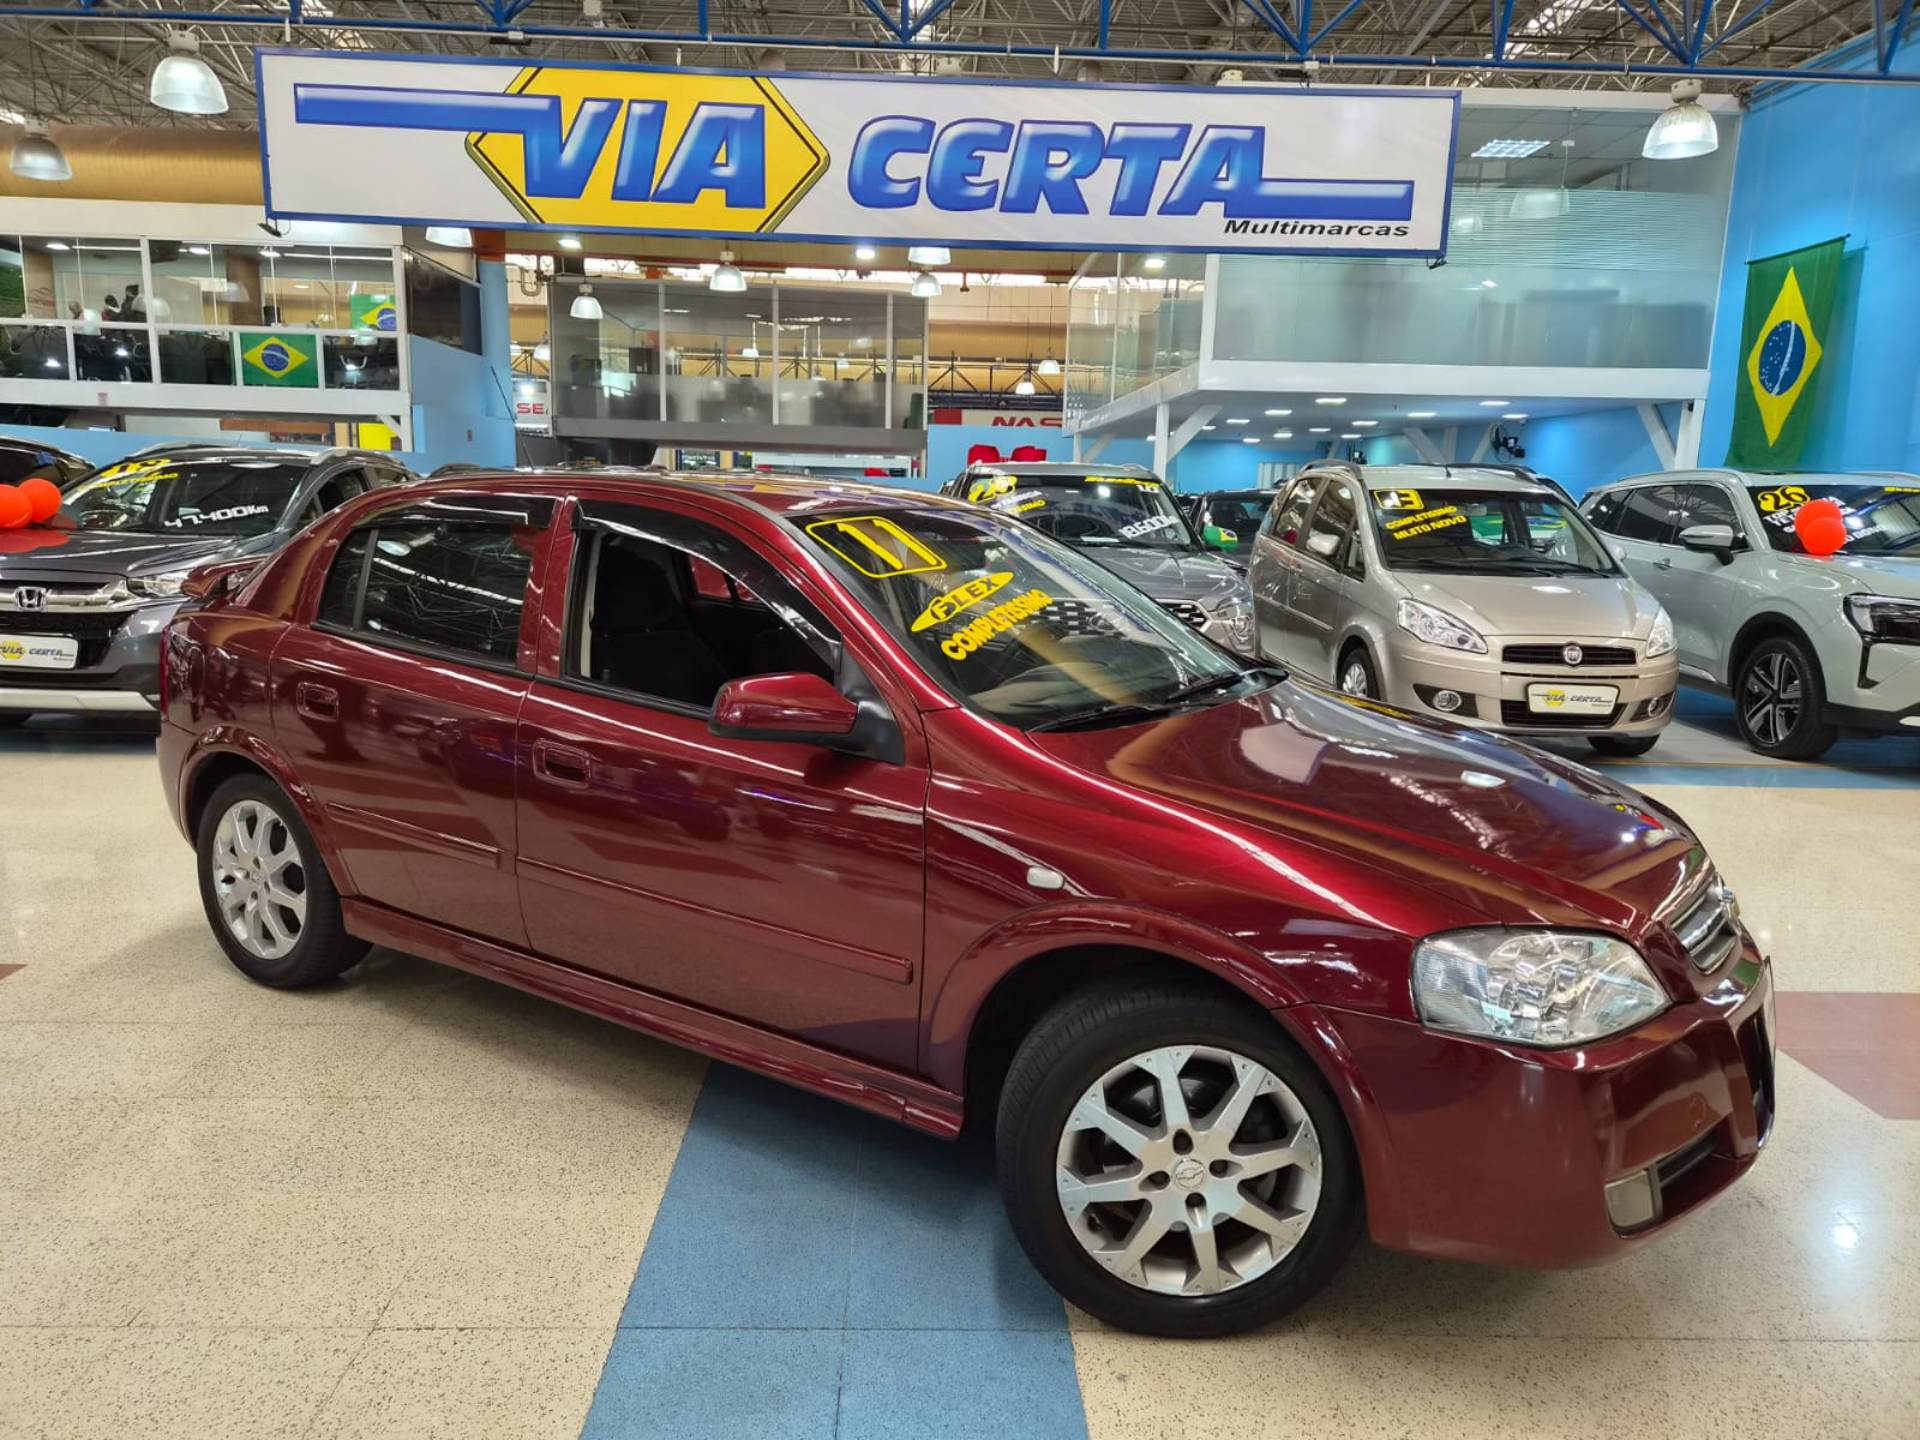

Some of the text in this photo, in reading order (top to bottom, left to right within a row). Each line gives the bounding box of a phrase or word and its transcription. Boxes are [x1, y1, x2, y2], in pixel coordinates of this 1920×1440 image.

[500, 93, 1268, 217] VIA CERTA
[1224, 218, 1410, 237] Multimarcas
[1759, 486, 1810, 510] 26
[1393, 514, 1467, 540] MUITO NOVO
[835, 519, 941, 571] 11
[931, 577, 998, 620] FLEX
